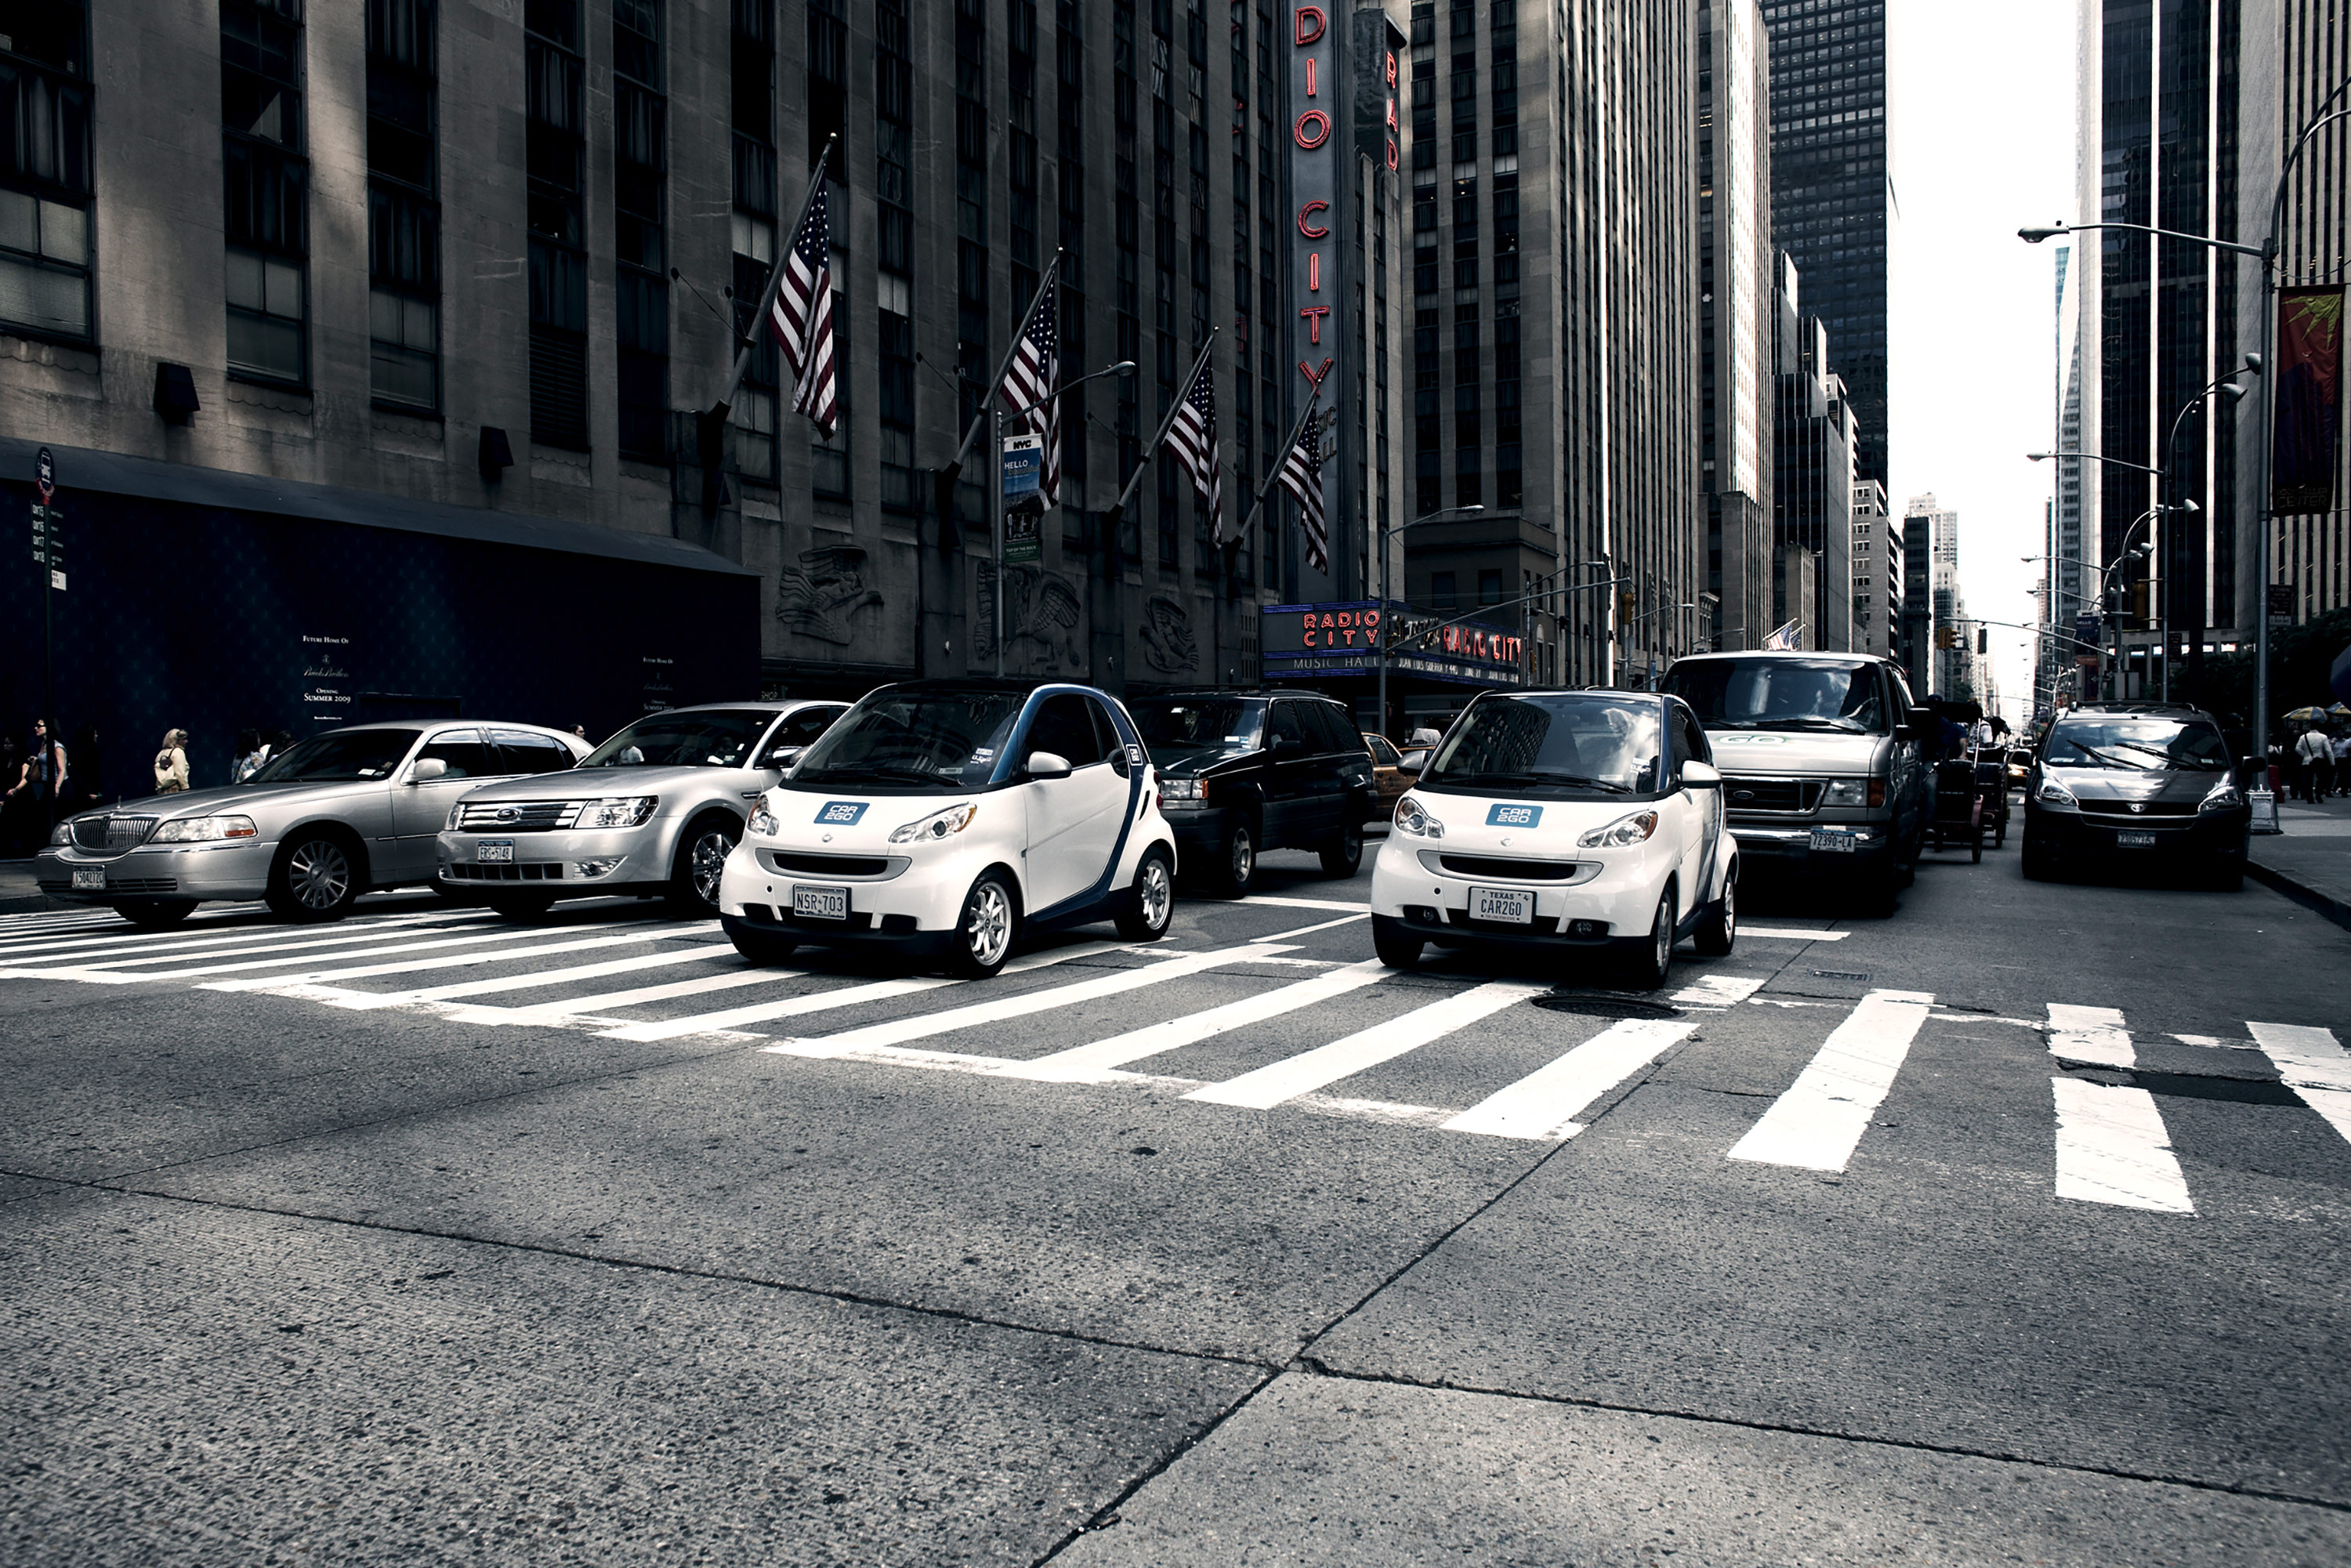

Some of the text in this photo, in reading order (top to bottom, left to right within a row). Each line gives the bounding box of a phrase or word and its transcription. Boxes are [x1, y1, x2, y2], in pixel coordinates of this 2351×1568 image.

[1298, 200, 1332, 396] CITY
[1013, 440, 1031, 450] NYC
[1004, 459, 1028, 469] HELLO
[1304, 610, 1379, 629] RADIO
[1304, 628, 1378, 647] CITY
[1443, 625, 1486, 657] RADIO
[1493, 634, 1521, 662] CITY
[1293, 657, 1379, 668] MUSIC HALL
[1398, 657, 1411, 668] JUAN
[1413, 660, 1424, 671] LUIS
[1425, 661, 1443, 672] GUERRA
[304, 693, 332, 701] SUMMER
[829, 805, 859, 813] CAR
[1499, 807, 1532, 817] CAR
[824, 812, 854, 820] 2GO
[1497, 814, 1530, 824] 2GO
[1480, 899, 1521, 916] CAR2GO
